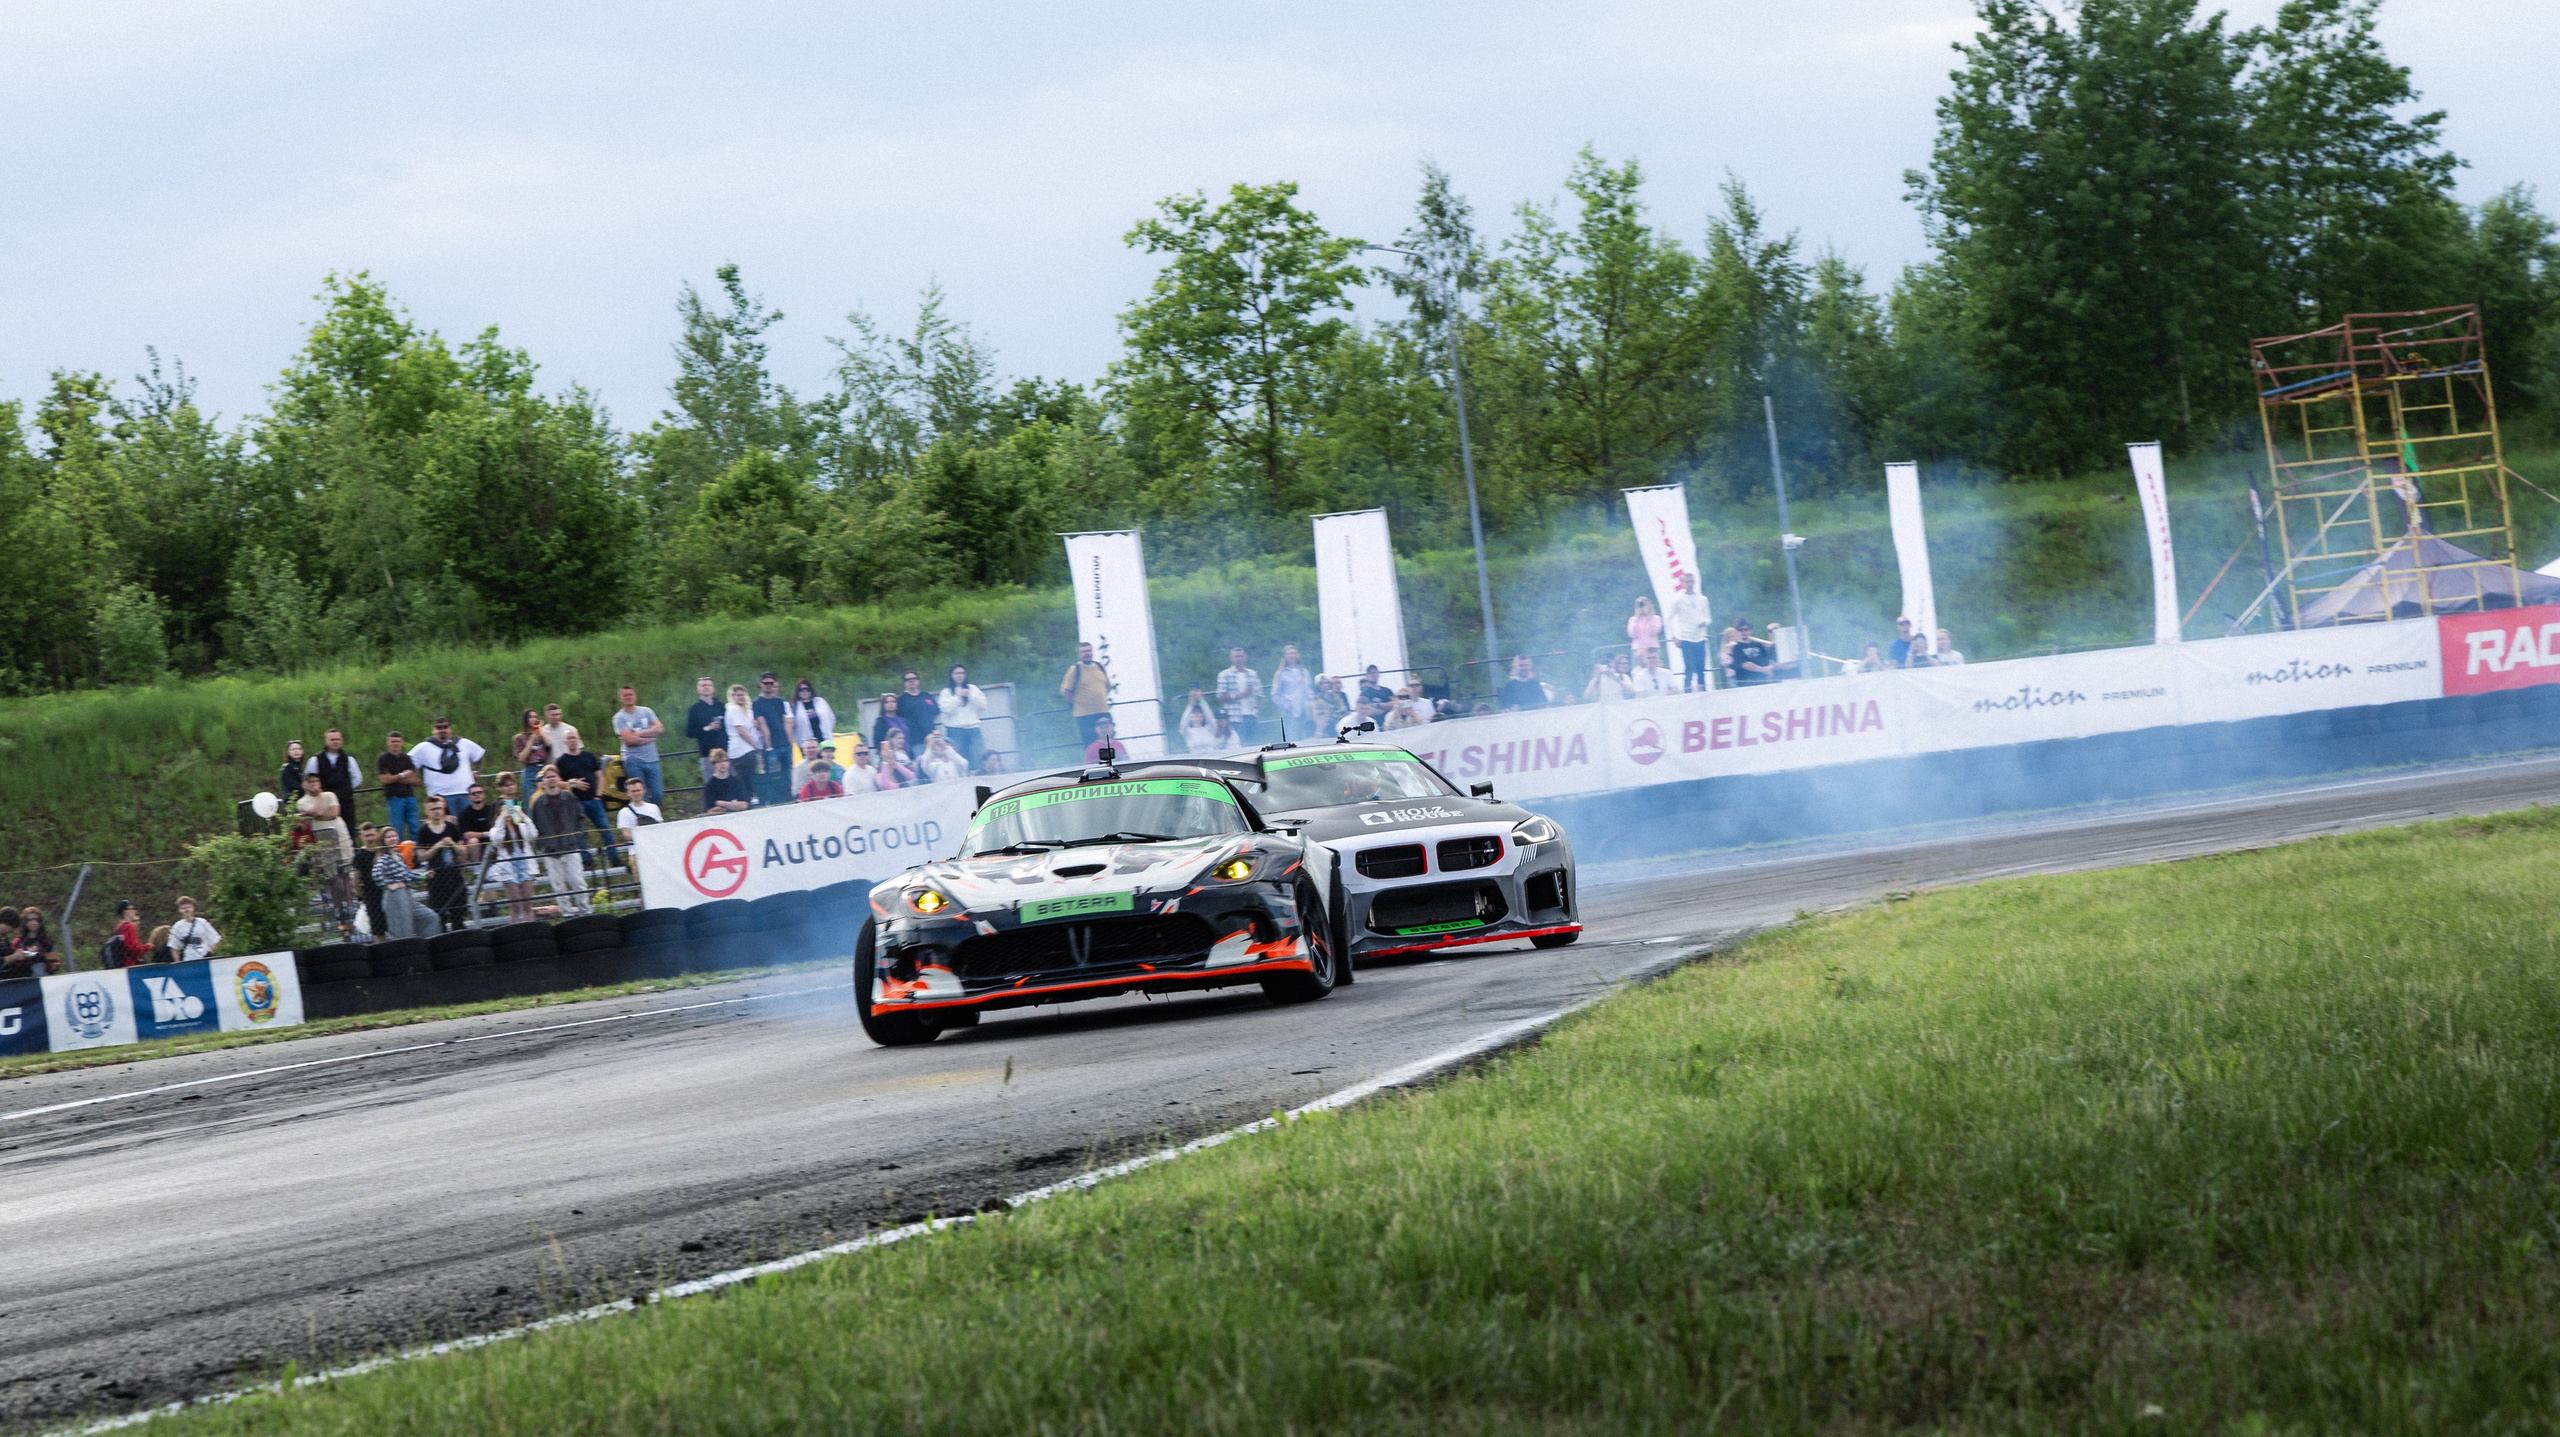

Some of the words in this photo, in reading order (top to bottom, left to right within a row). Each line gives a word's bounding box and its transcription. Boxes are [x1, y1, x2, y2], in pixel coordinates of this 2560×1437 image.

[2246, 657, 2353, 685] motion
[2366, 660, 2427, 674] PREMIUM
[1973, 684, 2086, 713] motion
[2102, 686, 2166, 700] PREMIUM
[1682, 699, 1885, 754] BELSHINA
[1286, 753, 1355, 767] ЮФЕРЕВ
[1418, 733, 1589, 780] LSHINA
[1047, 782, 1148, 804] ПОЛИЩУК
[992, 801, 1019, 819] 182
[1391, 806, 1444, 818] HOLZ
[1398, 810, 1465, 822] HOUSE
[762, 820, 942, 869] AutoGroup
[1037, 896, 1117, 915] BETERA
